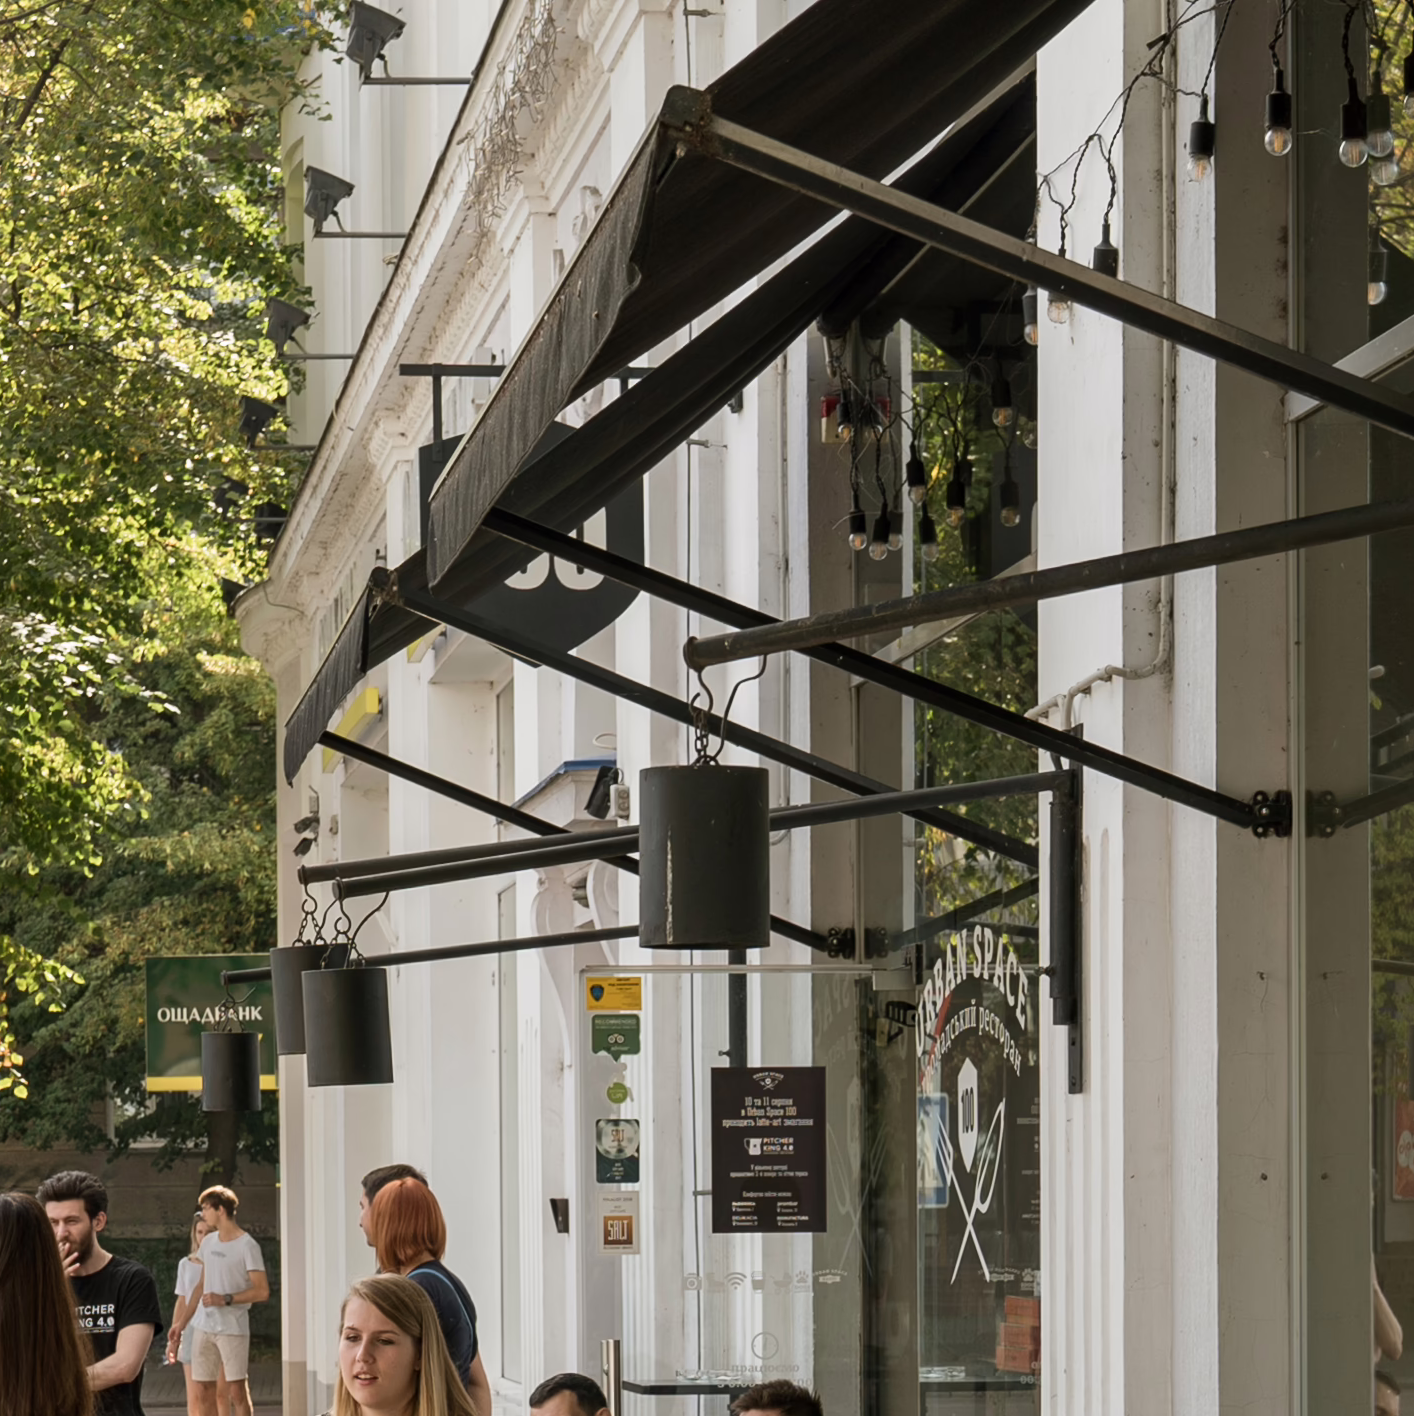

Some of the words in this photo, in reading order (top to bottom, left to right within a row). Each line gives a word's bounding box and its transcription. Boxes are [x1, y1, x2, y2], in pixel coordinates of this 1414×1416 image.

[915, 928, 968, 1058] URBAN
[973, 924, 1029, 1030] SPACE
[978, 1006, 1022, 1078] ресторан
[961, 1087, 975, 1134] 100
[607, 1219, 629, 1240] SALT
[75, 1303, 115, 1316] ITCHER
[78, 1317, 94, 1328] NG
